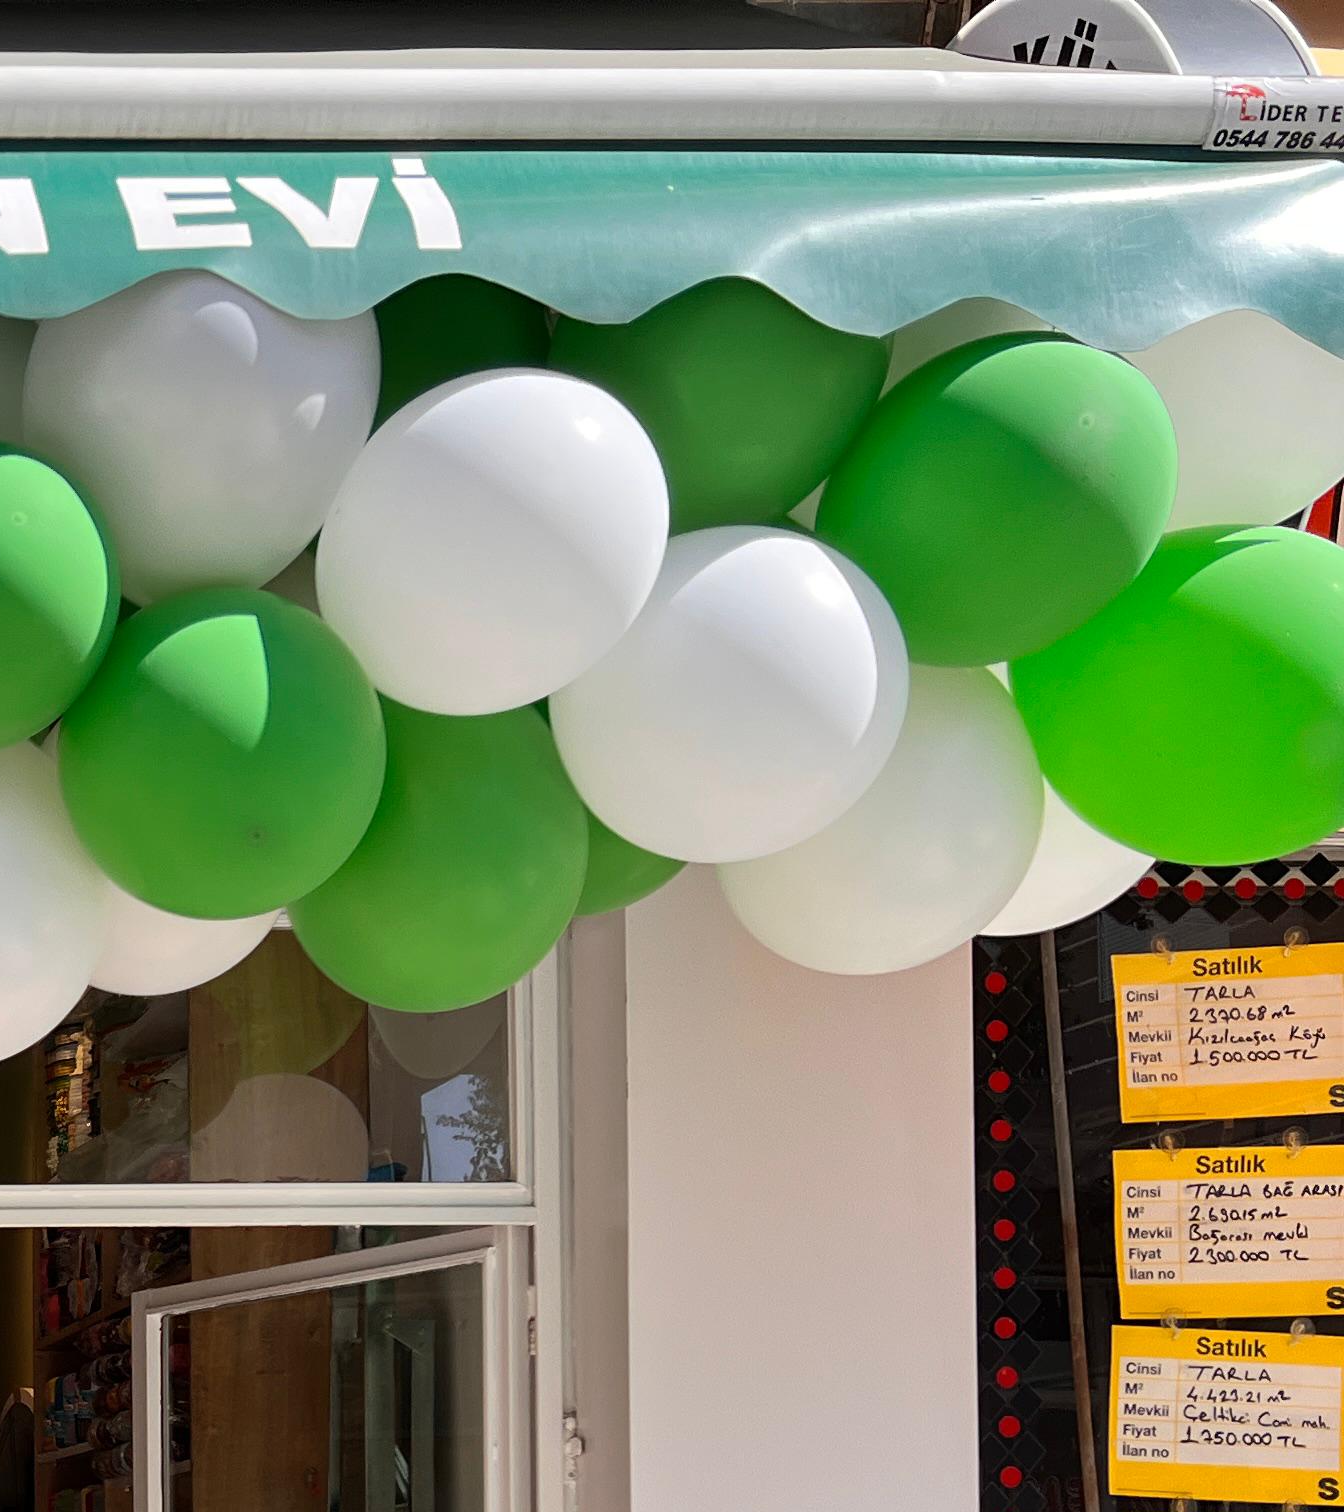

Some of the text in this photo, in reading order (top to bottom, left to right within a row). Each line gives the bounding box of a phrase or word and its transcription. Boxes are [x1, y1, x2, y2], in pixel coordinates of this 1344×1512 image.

[1213, 129, 1269, 147] 0544
[1274, 131, 1316, 149] 786
[116, 158, 462, 251] EVİ
[1192, 955, 1263, 976] Satılık
[1126, 990, 1159, 1002] Cinsi
[1184, 985, 1255, 1001] TARLA
[1128, 1030, 1172, 1043] Mevkii
[1130, 1051, 1163, 1065] Fiyat
[1284, 1049, 1318, 1060] TL
[1132, 1070, 1178, 1083] İlan no
[1196, 1155, 1265, 1174] Satılık
[1127, 1186, 1160, 1198] Cinsi
[1186, 1184, 1251, 1199] TARLA
[1128, 1227, 1172, 1239] Mevkii
[1129, 1248, 1161, 1262] Fiyat
[1280, 1250, 1310, 1260] TL
[1130, 1266, 1175, 1280] İlan no
[1197, 1336, 1266, 1358] Satılık
[1126, 1362, 1162, 1375] Cinsi
[1188, 1365, 1272, 1382] TARLA
[1124, 1404, 1169, 1417] Mevkii
[1123, 1424, 1156, 1439] Fiyat
[1276, 1437, 1306, 1448] TL
[1122, 1442, 1169, 1458] İlan no
